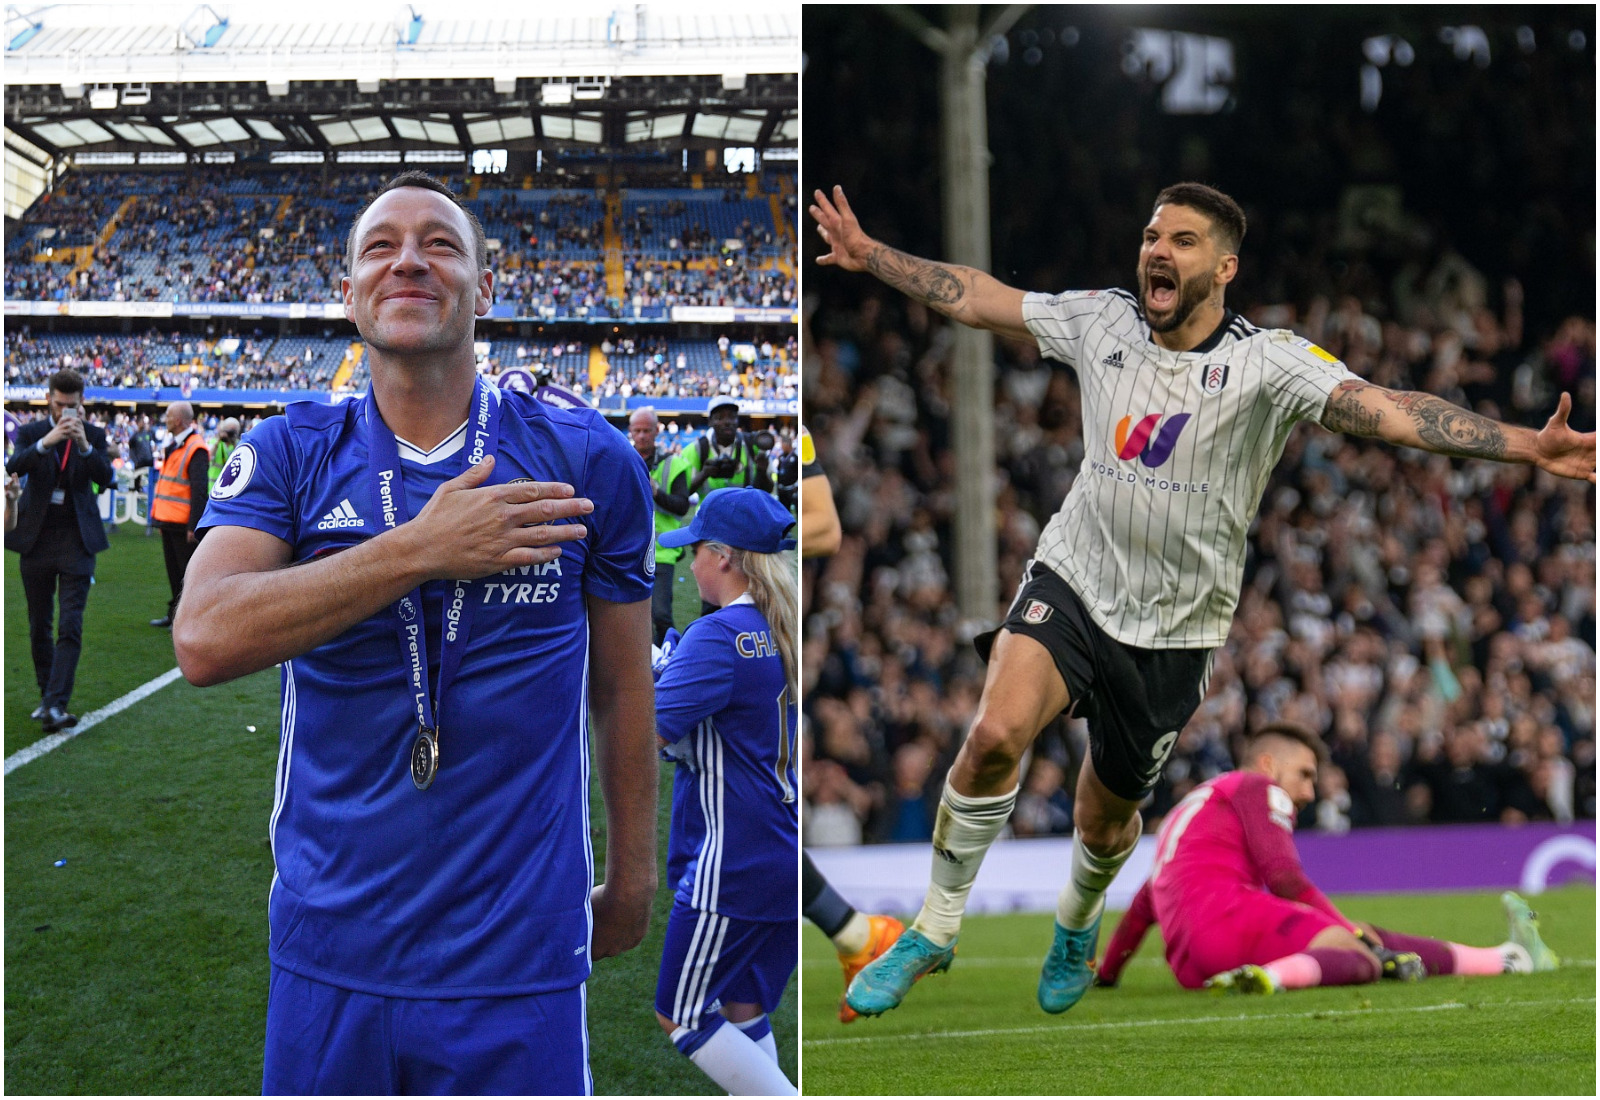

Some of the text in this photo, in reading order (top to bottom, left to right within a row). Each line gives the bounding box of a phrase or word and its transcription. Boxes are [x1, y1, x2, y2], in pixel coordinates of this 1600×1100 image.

[1102, 358, 1124, 369] adidas
[467, 382, 491, 467] Premier Leag
[378, 469, 398, 528] Premier
[1091, 460, 1209, 493] WORLD MOBILE
[317, 517, 365, 530] adidas
[446, 579, 472, 642] League
[482, 582, 561, 604] TYRES
[405, 624, 423, 689] Premier
